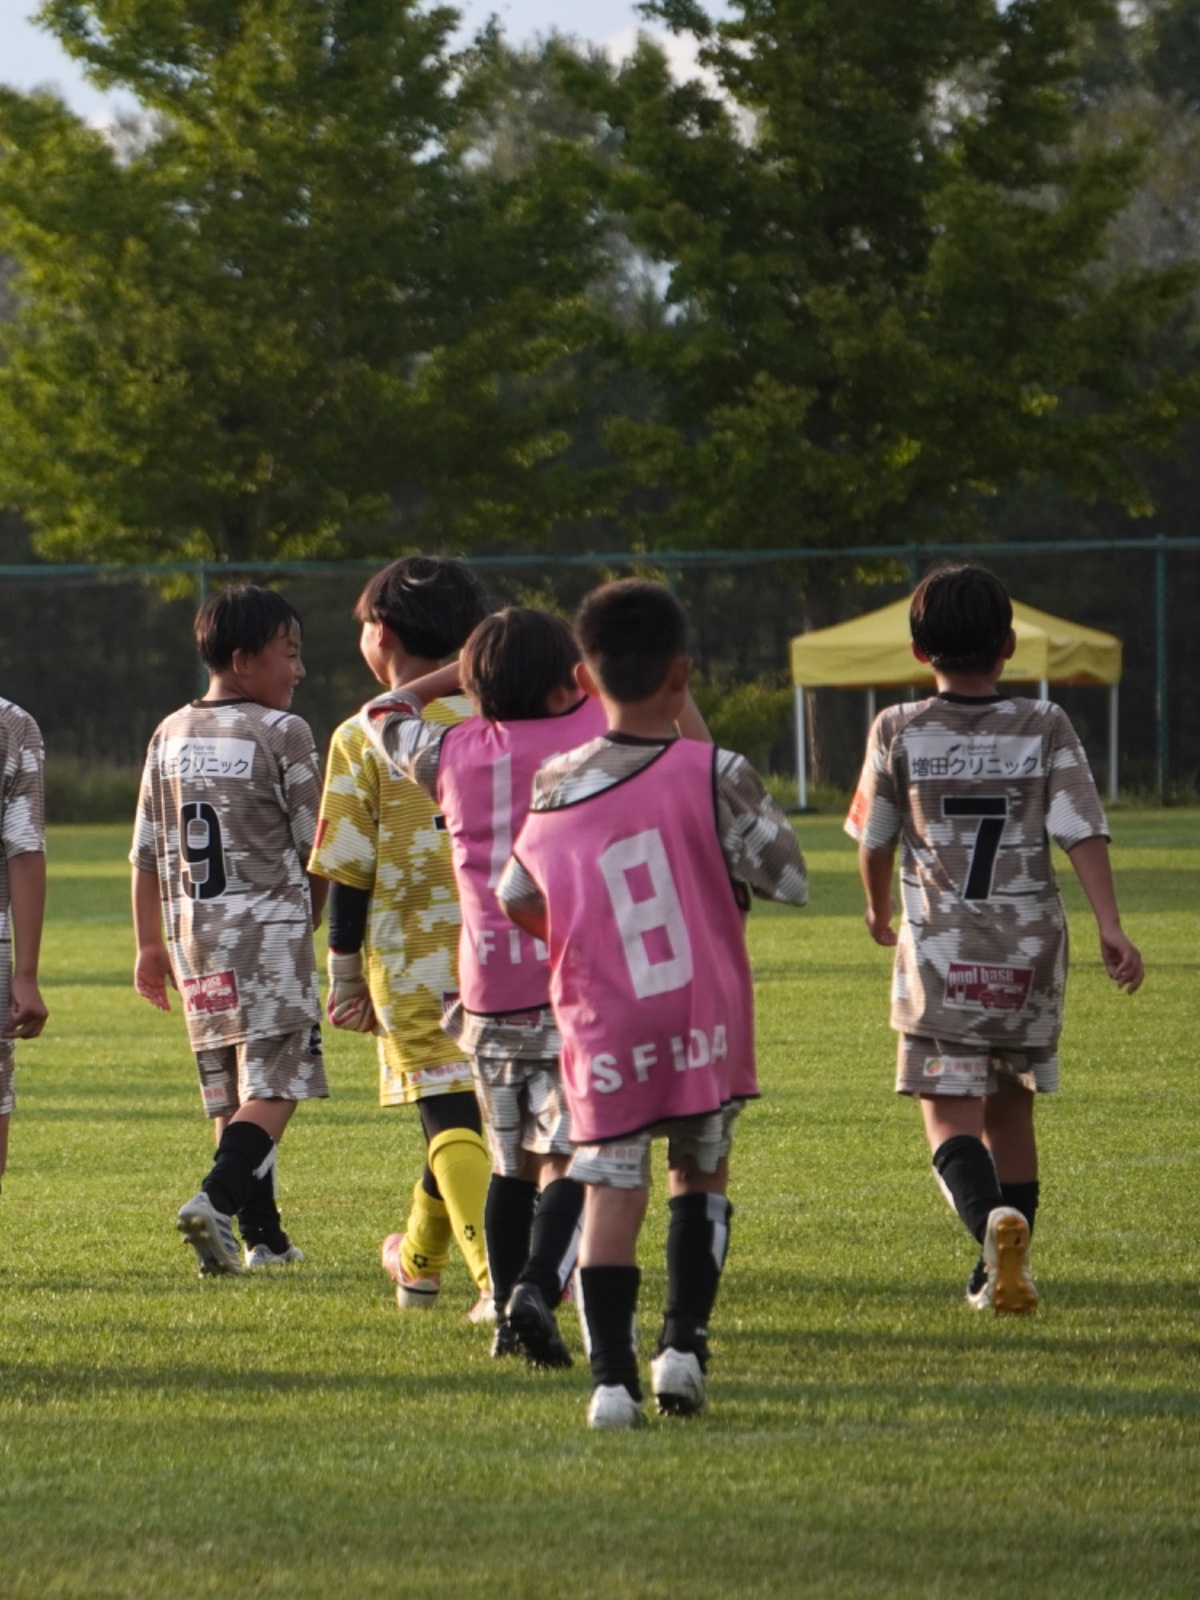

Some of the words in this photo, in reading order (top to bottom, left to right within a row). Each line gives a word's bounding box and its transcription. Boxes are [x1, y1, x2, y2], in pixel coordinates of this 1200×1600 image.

[912, 756, 1038, 777] 増田クリニック
[179, 801, 228, 901] 9
[941, 795, 1008, 901] 7
[598, 828, 693, 1001] 8
[981, 967, 1014, 984] base
